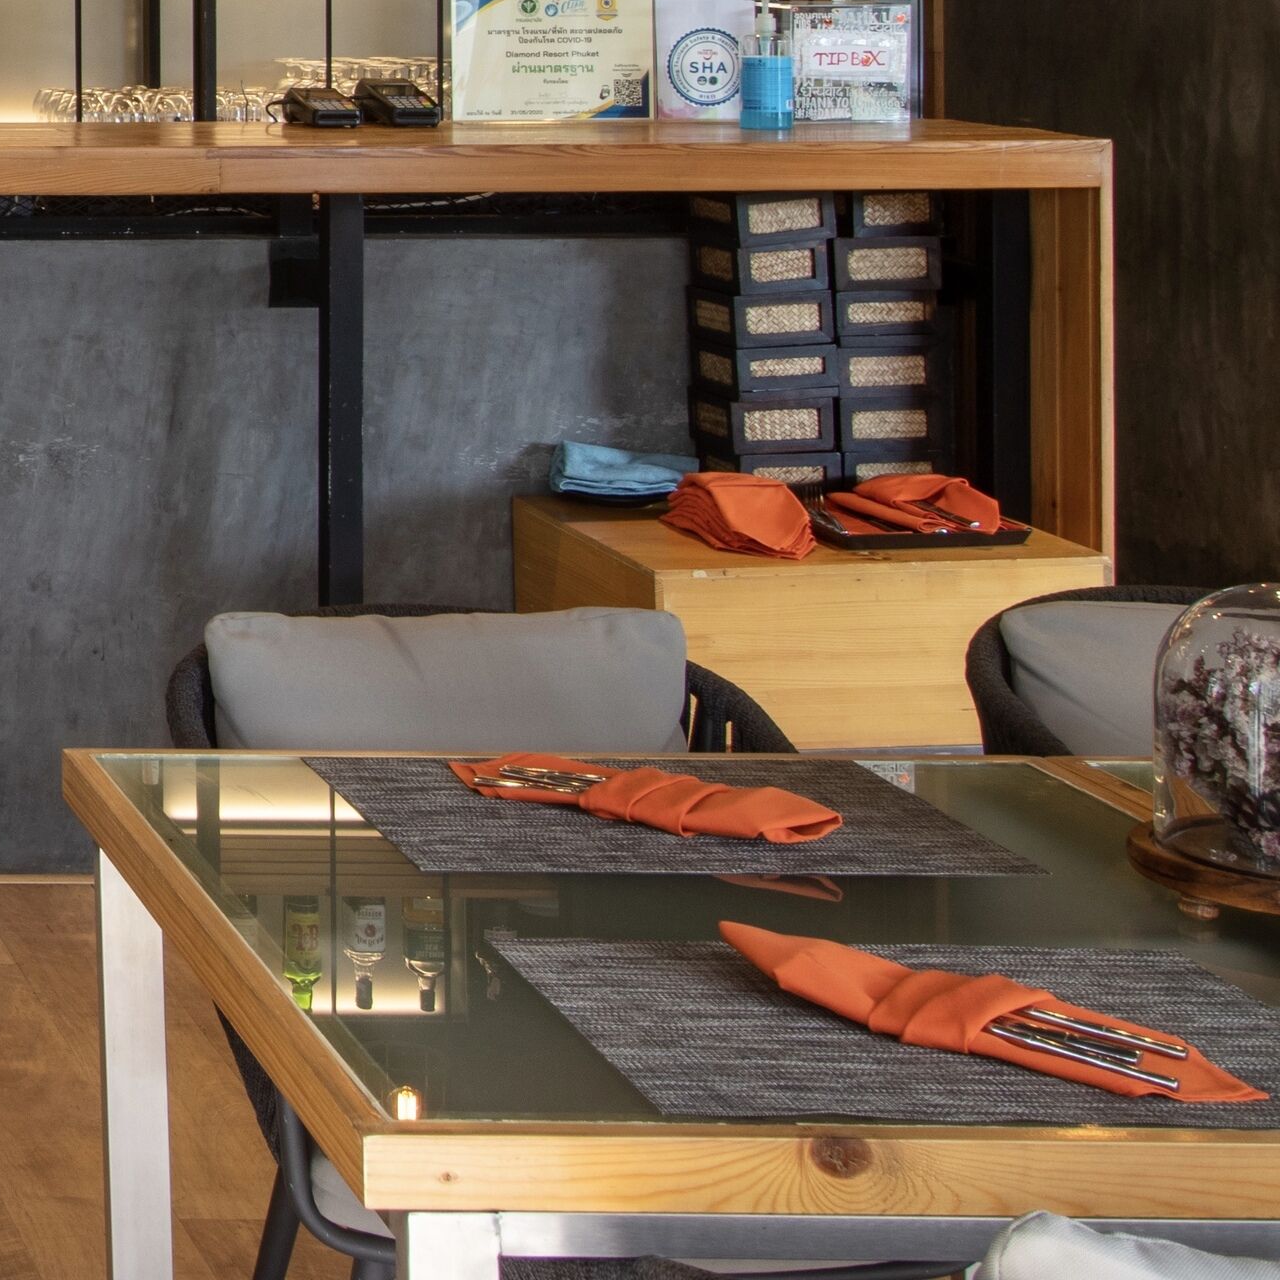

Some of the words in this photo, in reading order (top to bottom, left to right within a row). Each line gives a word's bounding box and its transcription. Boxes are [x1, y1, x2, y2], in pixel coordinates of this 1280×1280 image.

[487, 29, 520, 37] มาตรฐาน
[556, 36, 592, 44] COVID-19
[542, 50, 569, 58] Resort
[571, 50, 600, 58] Phuket
[813, 52, 848, 67] TIP
[511, 61, 594, 76] ผ่านมาตรฐาน
[689, 61, 728, 74] SHA
[794, 97, 835, 109] THANK
